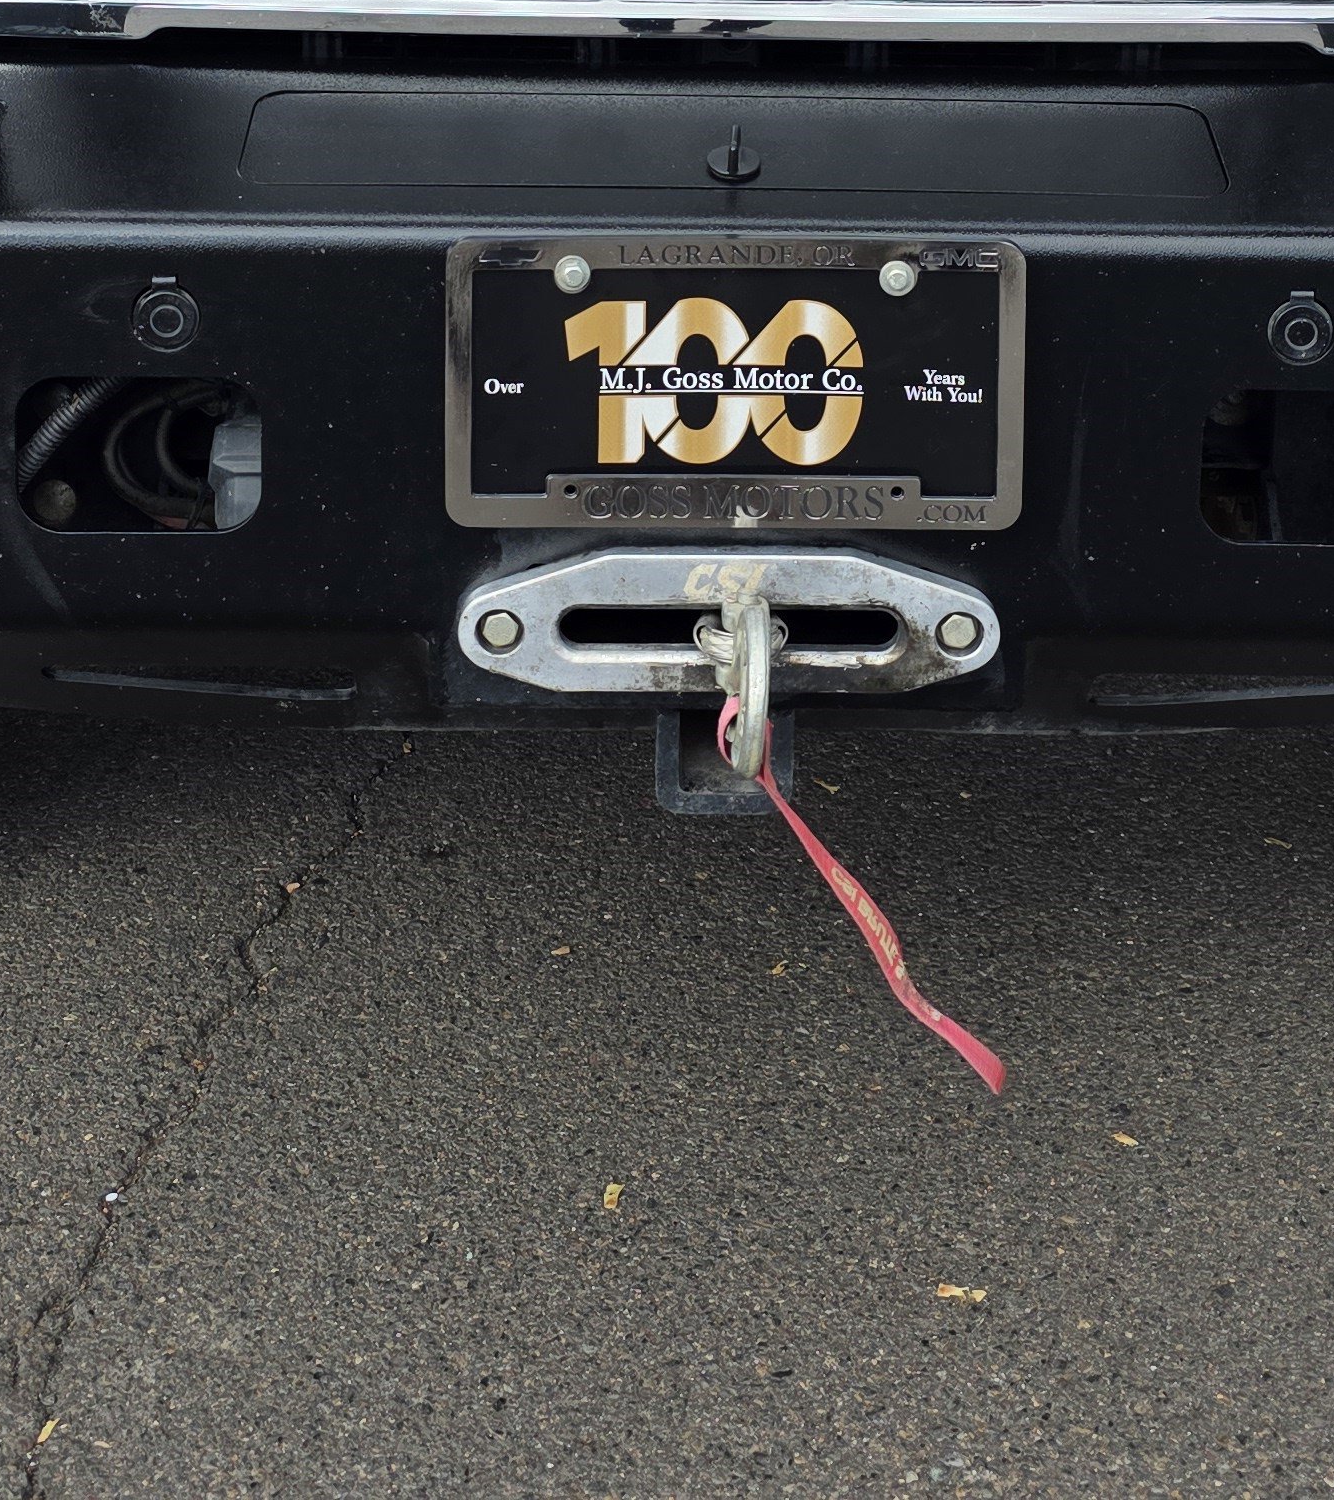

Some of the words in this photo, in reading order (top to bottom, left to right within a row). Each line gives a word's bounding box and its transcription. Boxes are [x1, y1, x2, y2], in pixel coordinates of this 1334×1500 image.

[812, 245, 856, 267] OR
[919, 248, 999, 267] GMC
[483, 378, 525, 396] Over
[563, 297, 864, 465] 100
[599, 367, 652, 390] M.J.
[662, 366, 724, 390] Goss
[733, 367, 814, 390] Motor
[822, 367, 864, 392] Co.
[922, 368, 966, 386] Years
[903, 385, 943, 402] With
[947, 386, 983, 404] You!
[583, 484, 692, 520] GOSS
[703, 484, 885, 520] MOTORS
[916, 504, 988, 524] .COM
